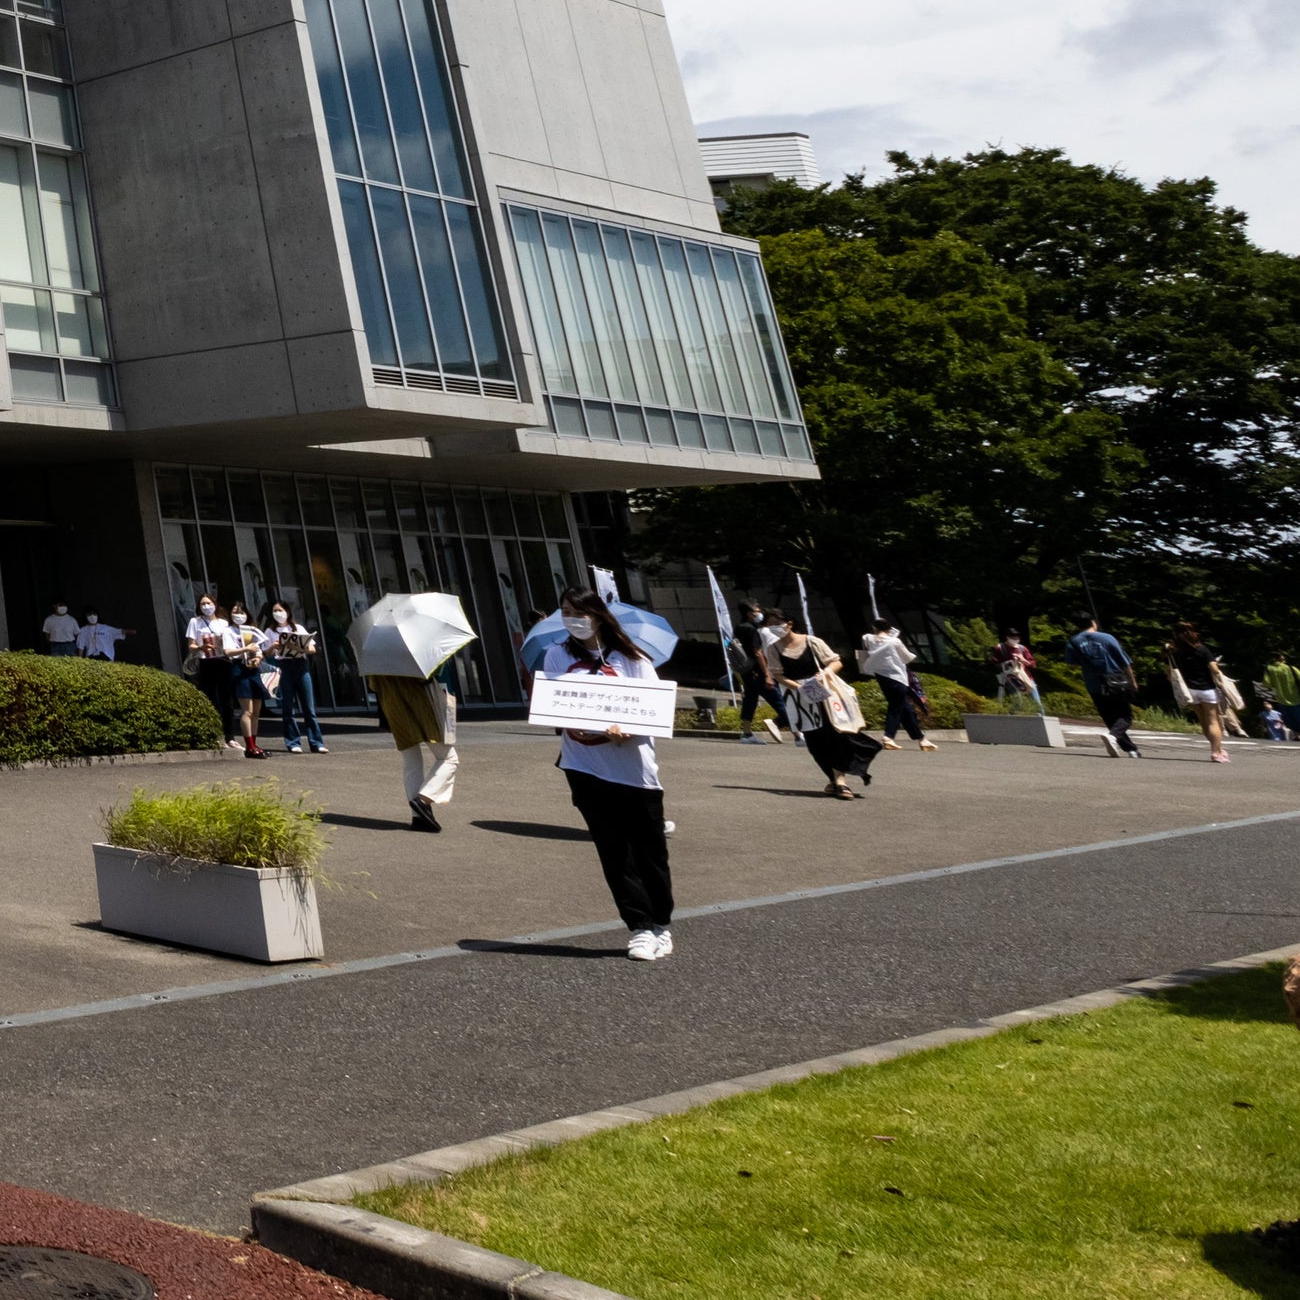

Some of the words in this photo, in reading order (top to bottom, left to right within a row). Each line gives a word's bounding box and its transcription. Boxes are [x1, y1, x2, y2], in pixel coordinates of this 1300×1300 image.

[552, 700, 657, 717] アートテーク展示はこちら
